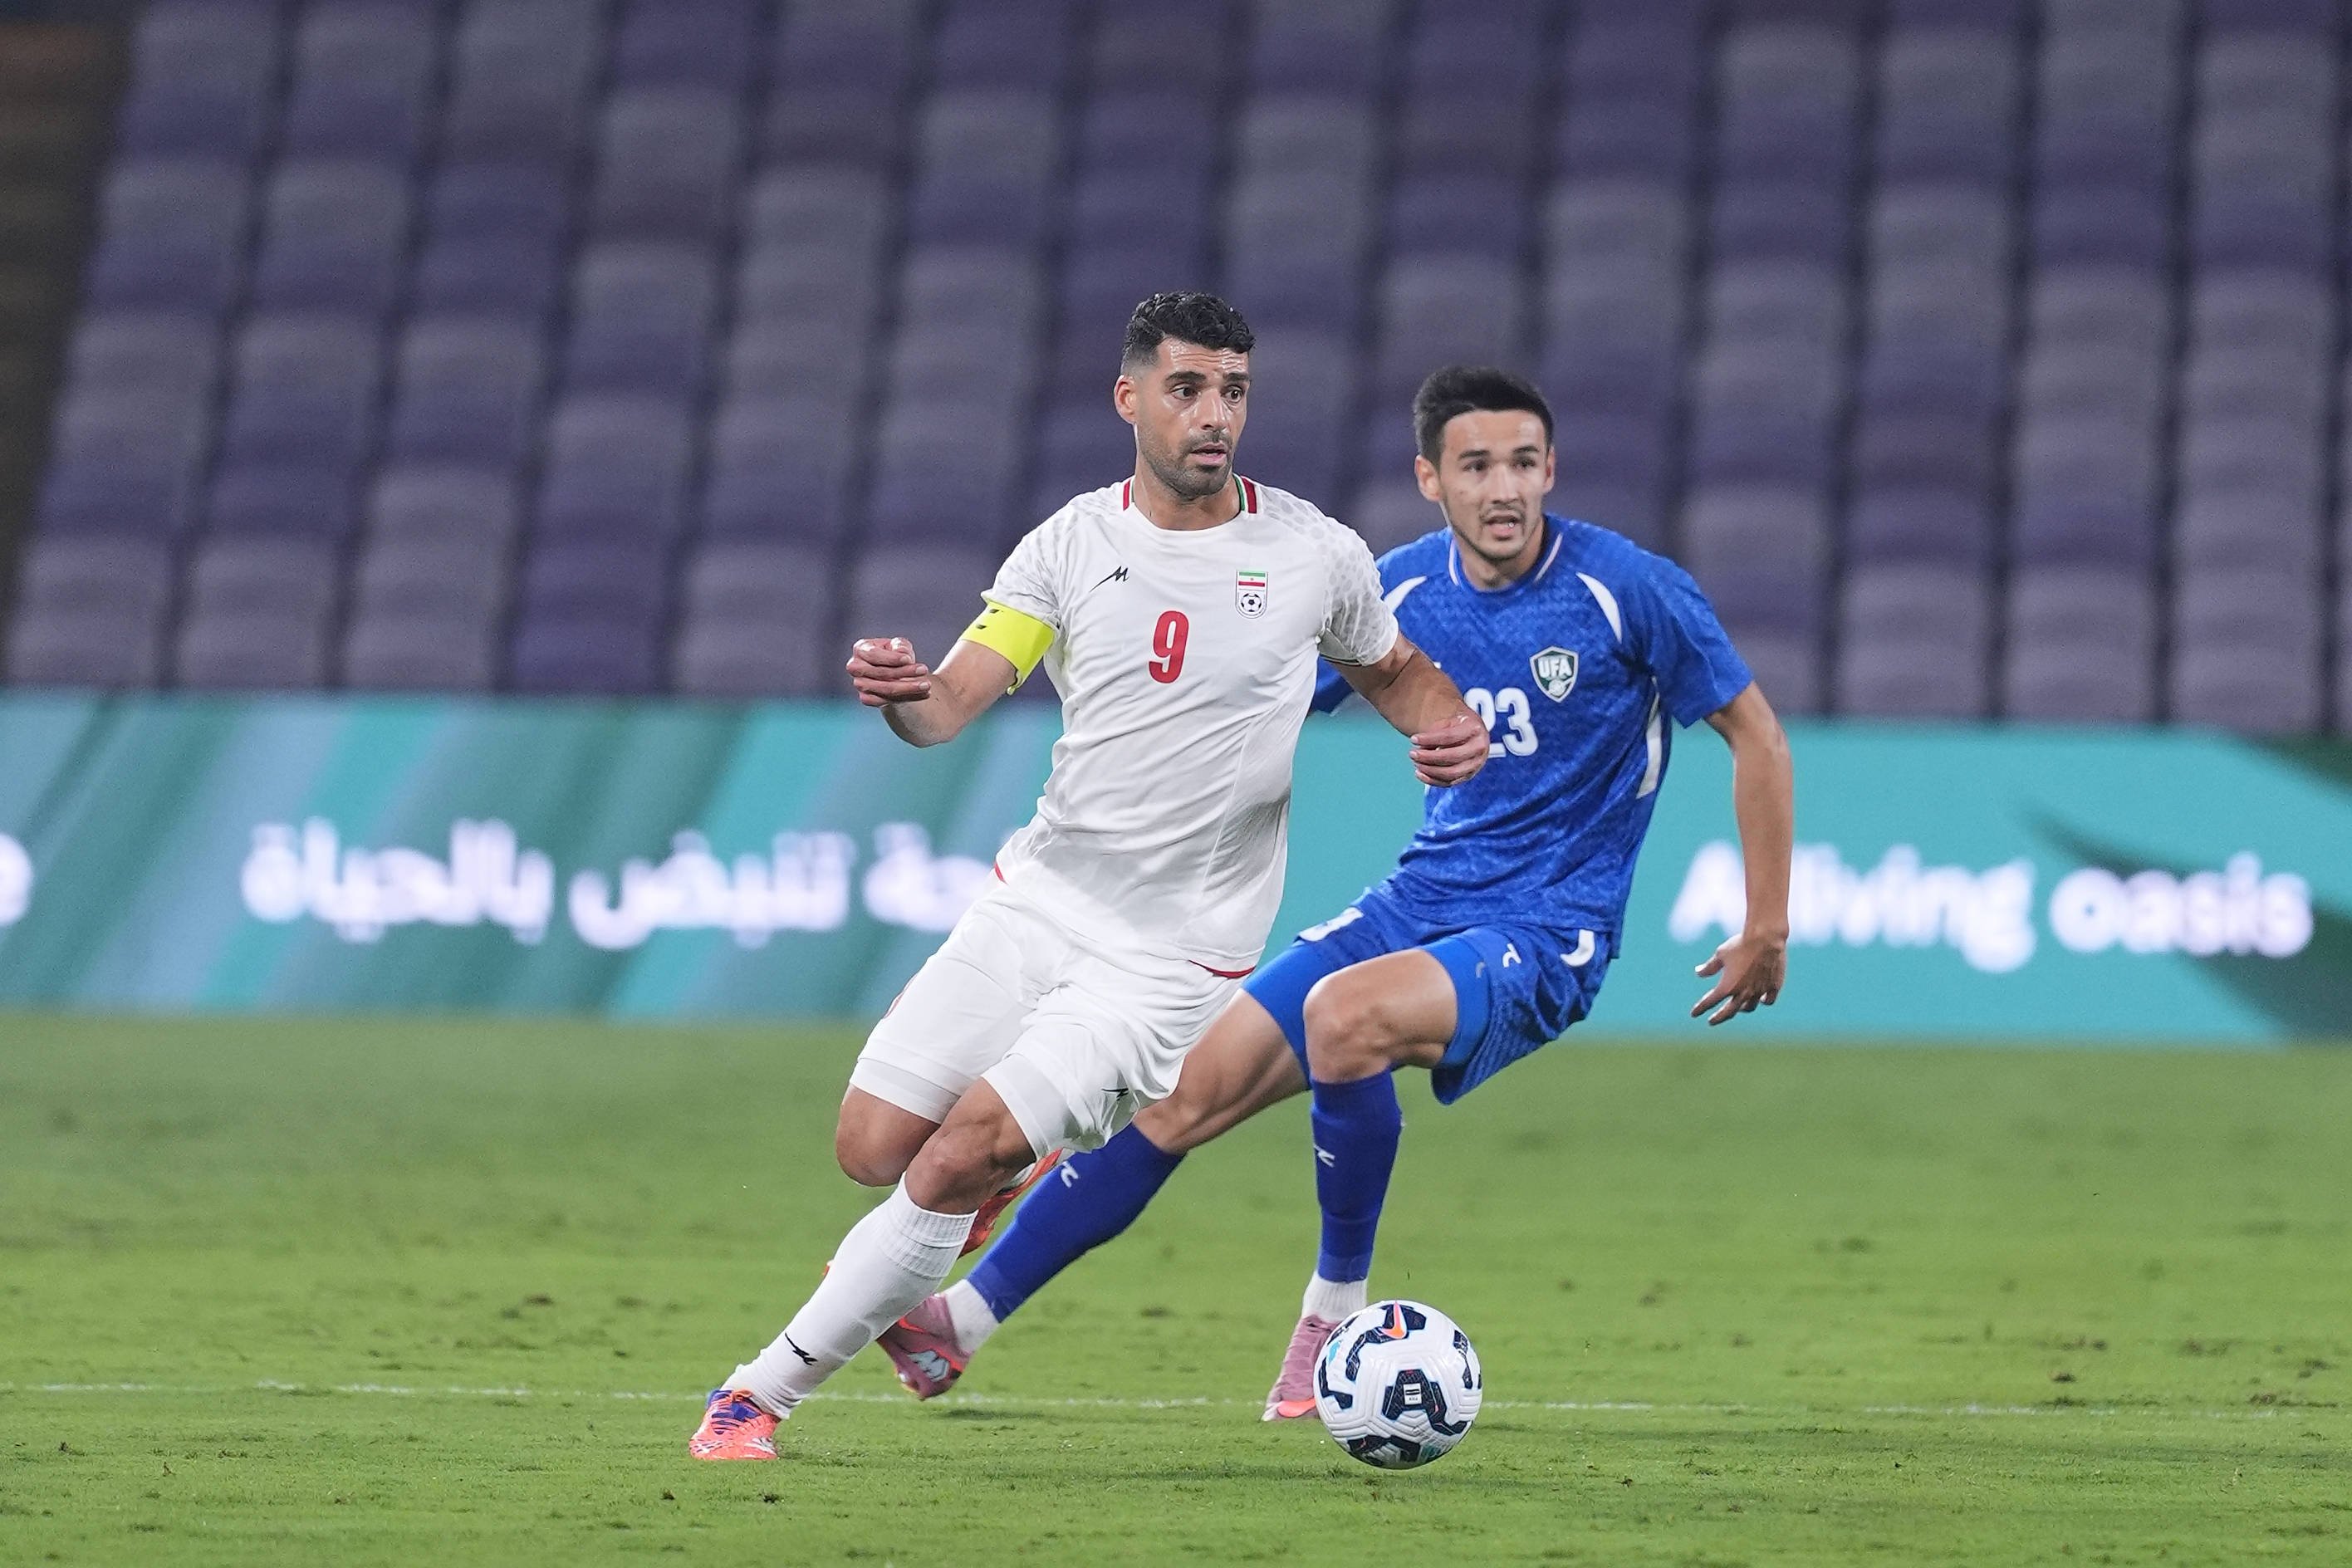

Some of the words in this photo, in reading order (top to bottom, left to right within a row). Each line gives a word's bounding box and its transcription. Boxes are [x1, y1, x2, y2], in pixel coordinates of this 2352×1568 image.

[1149, 610, 1189, 684] 9
[1538, 656, 1573, 680] UFA
[1463, 687, 1539, 757] 23
[1669, 840, 1747, 944] A
[2049, 852, 2314, 958] oasis
